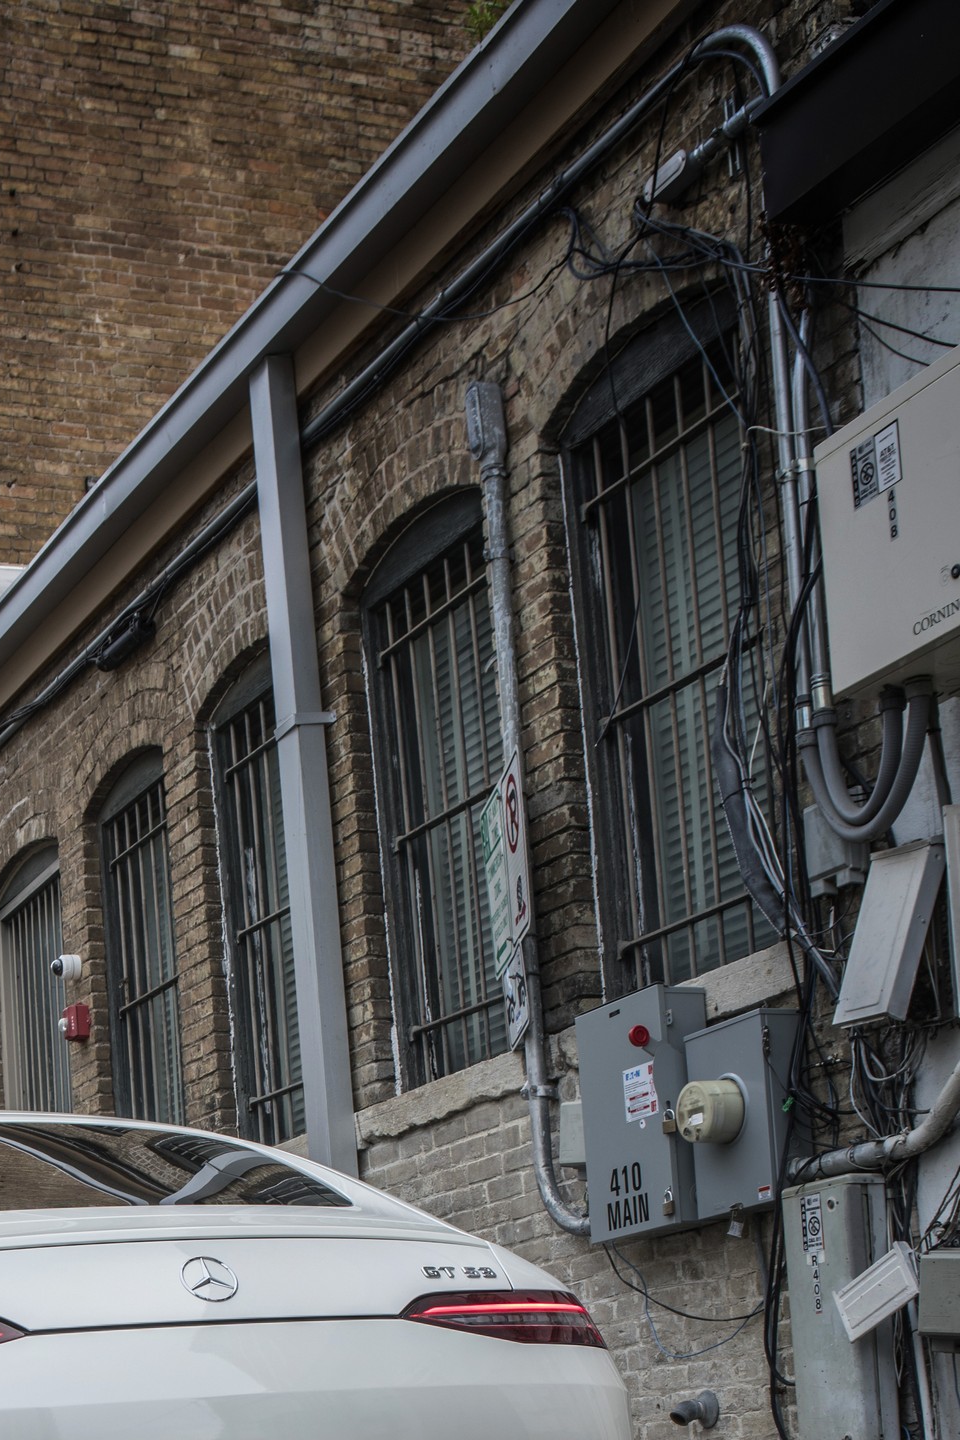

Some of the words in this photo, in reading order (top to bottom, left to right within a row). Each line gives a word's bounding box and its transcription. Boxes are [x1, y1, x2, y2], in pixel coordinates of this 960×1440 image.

[880, 442, 895, 458] AT&T
[888, 489, 898, 538] 408
[610, 1161, 642, 1197] 410
[607, 1192, 650, 1231] MAIN
[421, 1266, 455, 1279] GT
[461, 1266, 497, 1279] 53
